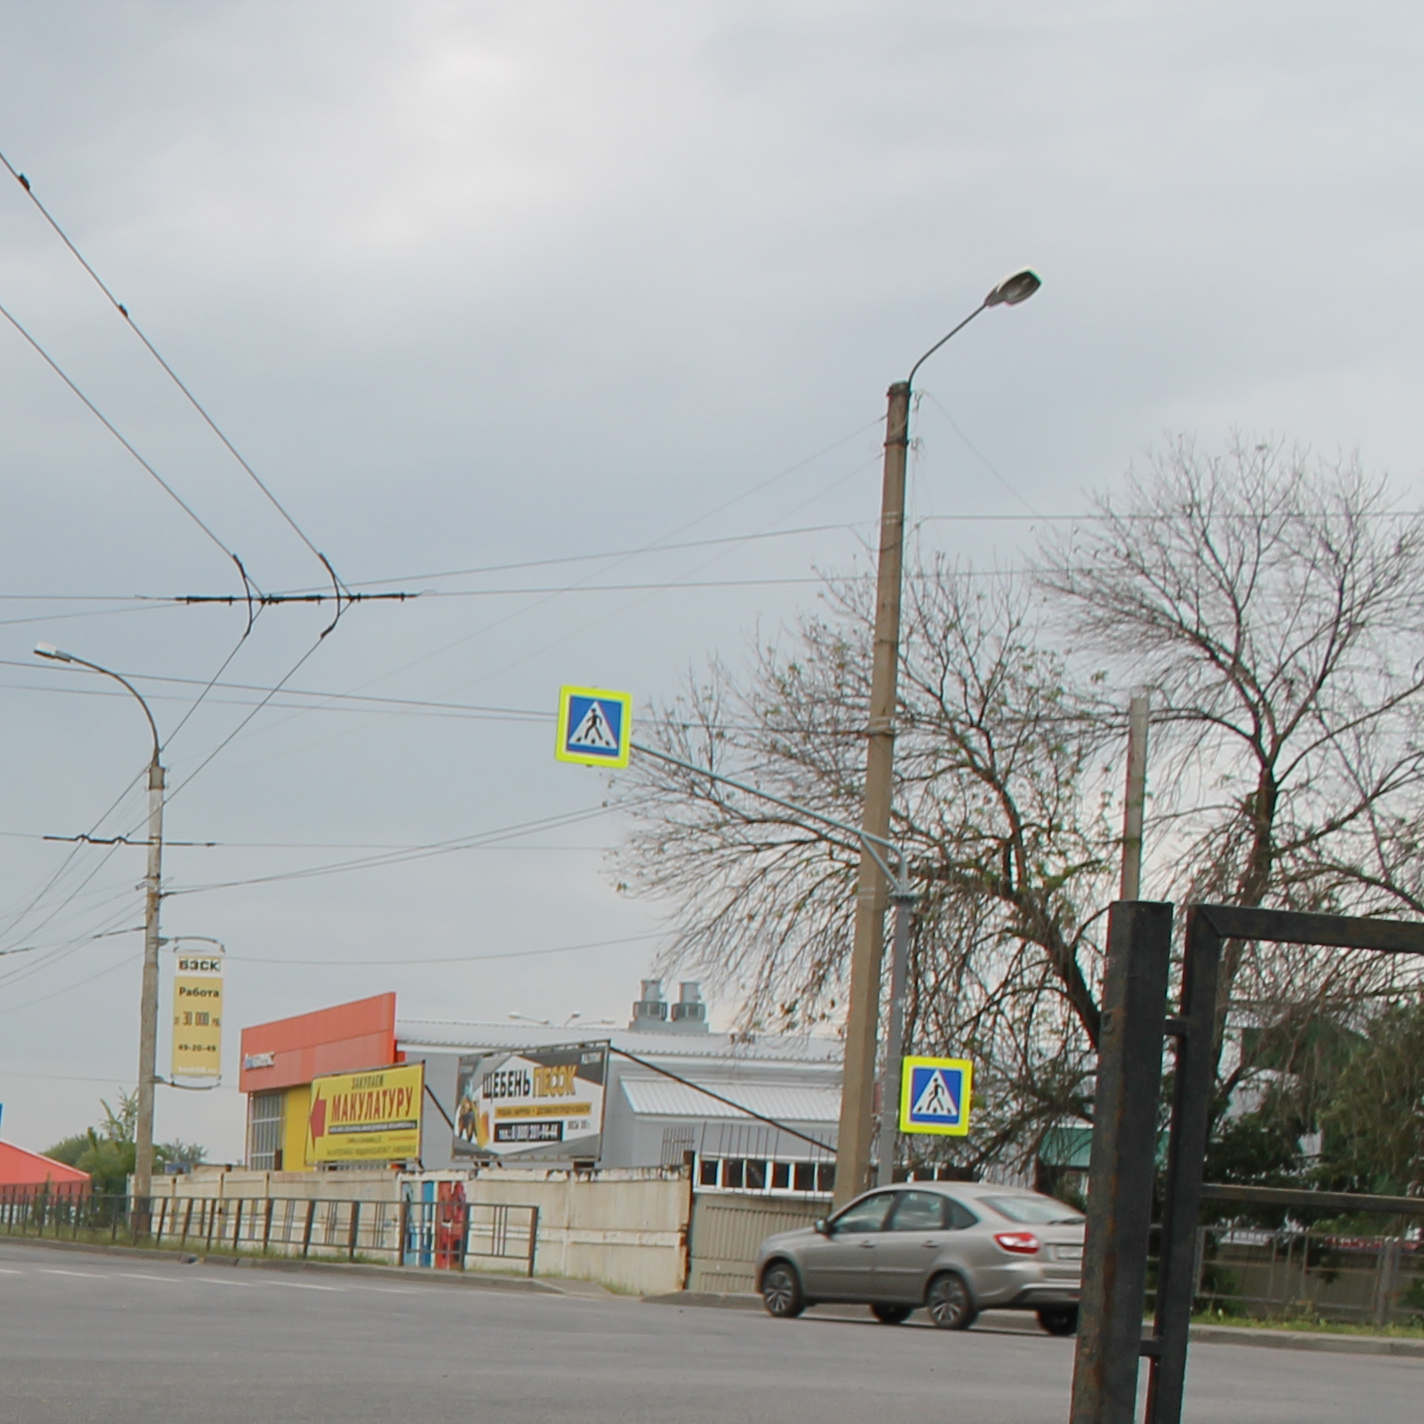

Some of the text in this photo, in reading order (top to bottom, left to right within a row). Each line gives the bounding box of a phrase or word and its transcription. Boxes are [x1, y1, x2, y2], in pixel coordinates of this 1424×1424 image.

[179, 987, 219, 998] Работа
[178, 1044, 216, 1052] 49-20-49
[483, 1065, 578, 1103] ЩЕБЕНЬ ПЕСОК
[332, 1086, 413, 1122] МАКУЛАТУРУ
